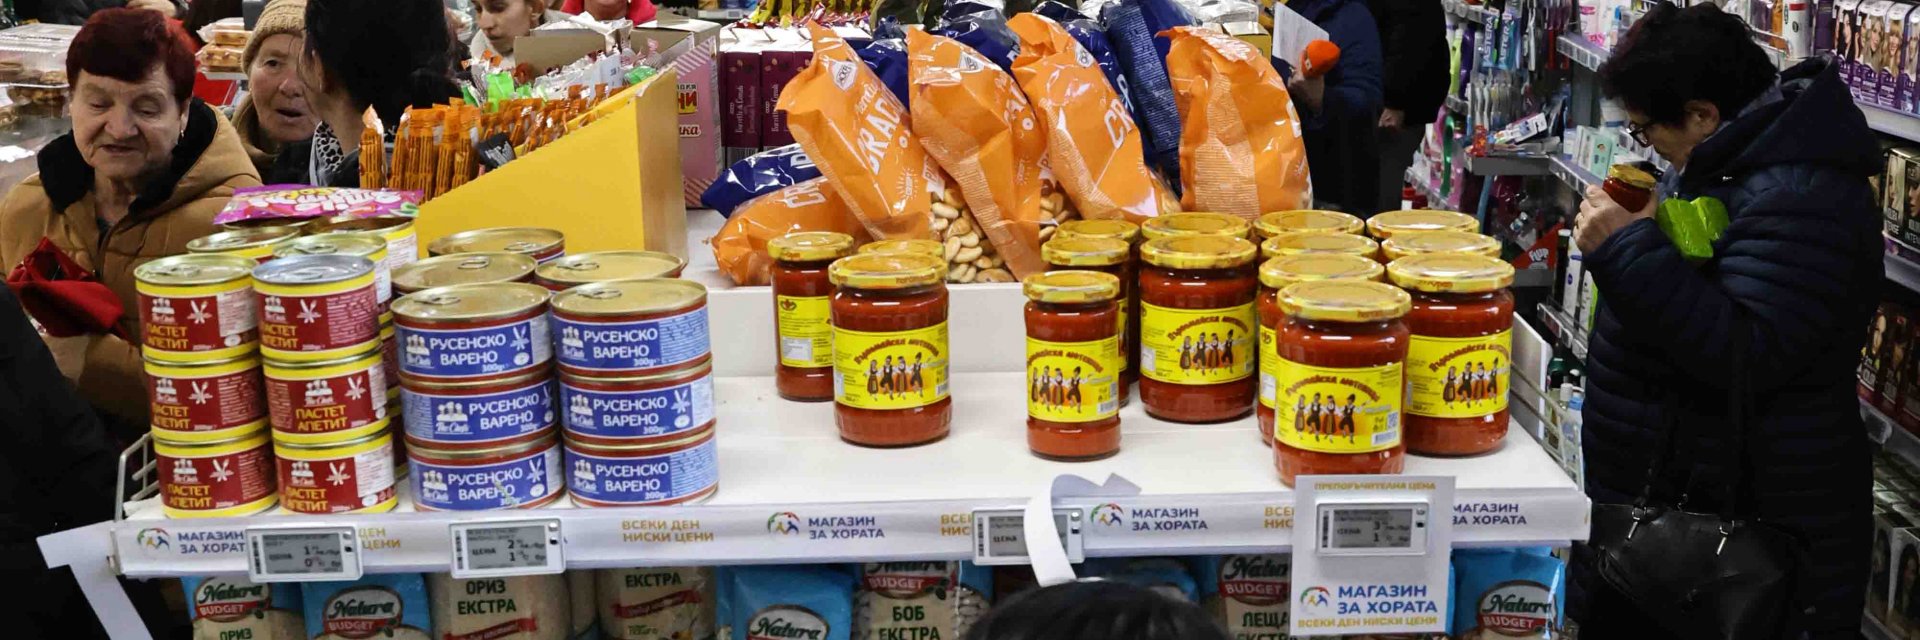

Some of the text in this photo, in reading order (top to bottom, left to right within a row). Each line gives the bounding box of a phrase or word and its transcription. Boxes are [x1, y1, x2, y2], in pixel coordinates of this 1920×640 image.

[1483, 16, 1494, 65] ASTERA
[1499, 20, 1510, 63] ASTERA
[429, 334, 506, 350] РУСЕНСКО
[583, 328, 658, 343] РУСЕНСКО
[440, 351, 498, 366] ВАРЕНО
[593, 345, 649, 359] ВАРЕНО
[469, 393, 540, 415] РУСЕНСКО
[593, 397, 668, 411] РУСЕНСКО
[295, 405, 346, 419] ПАСТЕТ
[298, 417, 348, 431] АПЕТИТ
[480, 410, 533, 430] ВАРЕНО
[603, 413, 659, 427] ВАРЕНО
[596, 462, 669, 477] РУСЕНСКО
[447, 468, 523, 485] РУСЕНСКО
[167, 484, 210, 496] ПАСТЕТ
[605, 479, 660, 492] ВАРЕНО
[1408, 482, 1436, 491] ЦЕНА
[458, 484, 515, 501] ВАРЕНО
[1132, 507, 1199, 519] МАГАЗИН
[1264, 506, 1294, 516] ВСЕ
[1453, 503, 1519, 513] МАГАЗИН
[622, 520, 700, 531] ВСЕКИ ДЕН
[809, 517, 875, 527] МАГАЗИН
[941, 514, 972, 524] ВСЕ
[1132, 519, 1208, 531] ЗА ХОРАТА
[1264, 519, 1293, 529] НИС
[1452, 515, 1527, 525] ЗА ХОРАТА
[178, 531, 244, 542] МАГАЗИН
[624, 532, 714, 543] НИСКИ ЦЕНИ
[809, 528, 885, 540] ЗА ХОРАТА
[941, 526, 971, 536] НИС
[180, 542, 245, 554] ЗА ХОРАТ
[362, 539, 401, 550] ЦЕНИ
[1224, 556, 1289, 580] Natur
[625, 572, 682, 588] ЕКСТРА
[868, 577, 925, 589] BUDGET
[198, 583, 263, 604] Natura
[466, 580, 506, 595] ОРИЗ
[1225, 583, 1283, 594] BUDGET
[1338, 585, 1426, 598] МАГАЗИН
[199, 605, 244, 615] BUDGET
[328, 599, 394, 618] Natura
[458, 599, 517, 615] ЕКСТРА
[892, 606, 925, 621] БОБ
[1337, 601, 1437, 614] ЗА ХОРАТА
[329, 620, 375, 631] BUDGET
[1298, 616, 1437, 628] ВСЕКИ ДЕН НИСКИ ЦЕНИ
[1483, 616, 1534, 628] BUDGET
[750, 618, 821, 640] Natura
[879, 627, 940, 640] ЕКСТРА
